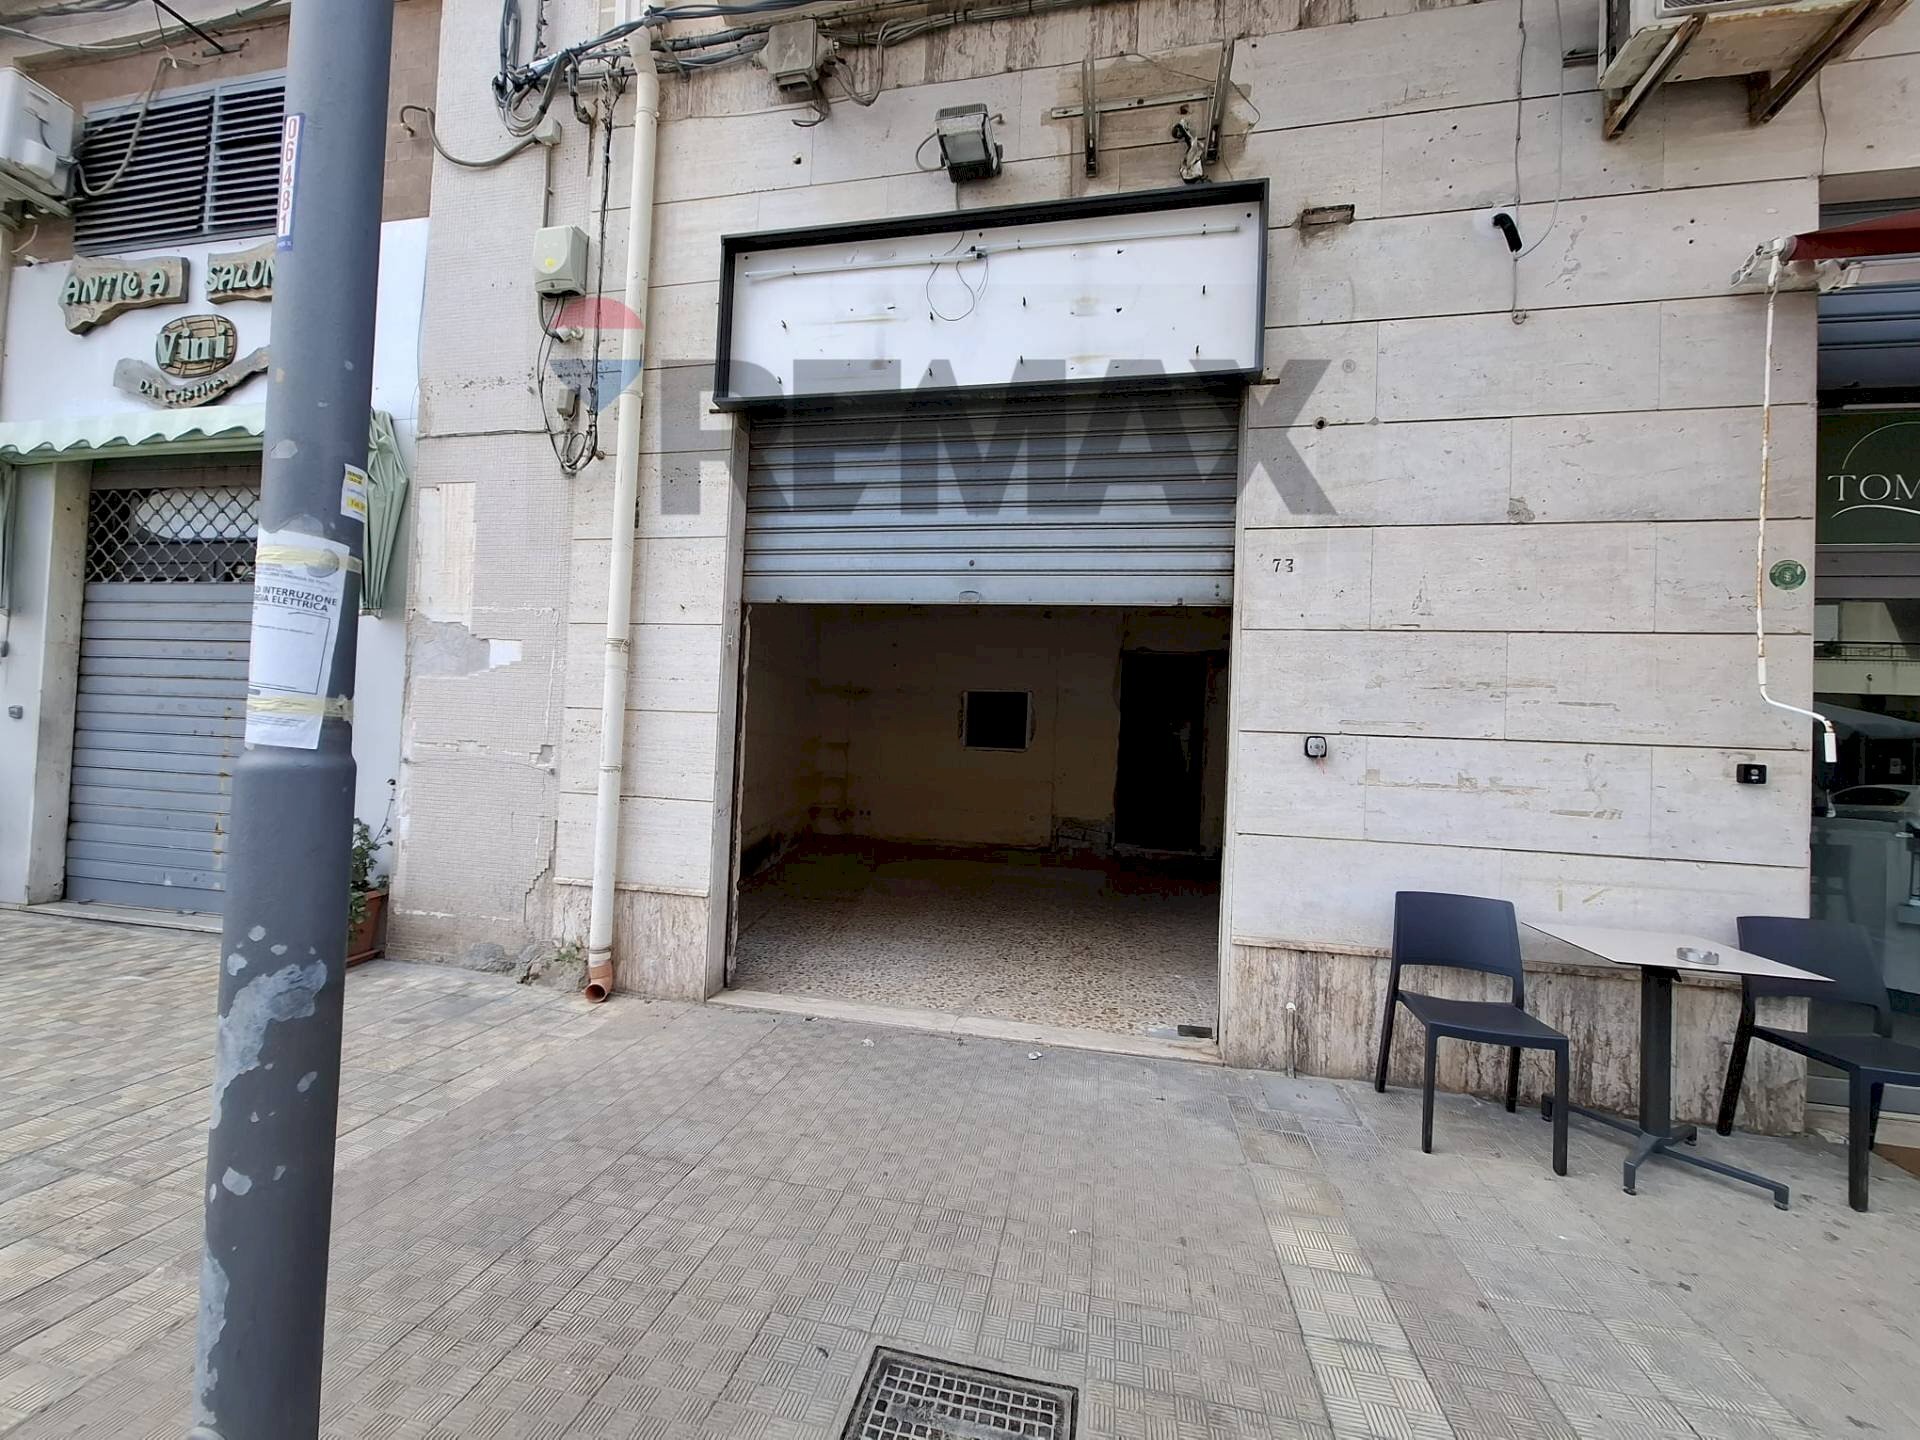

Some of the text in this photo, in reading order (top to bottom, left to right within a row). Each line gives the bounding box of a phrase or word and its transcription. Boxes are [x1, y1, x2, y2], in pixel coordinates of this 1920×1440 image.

[281, 118, 297, 235] 06481
[63, 268, 169, 306] ANTICA
[156, 325, 227, 365] Vini
[1827, 473, 1920, 501] TOM
[1272, 558, 1294, 573] 73
[263, 586, 338, 606] INTERRUZIONE
[271, 595, 329, 612] ELETTRICA
